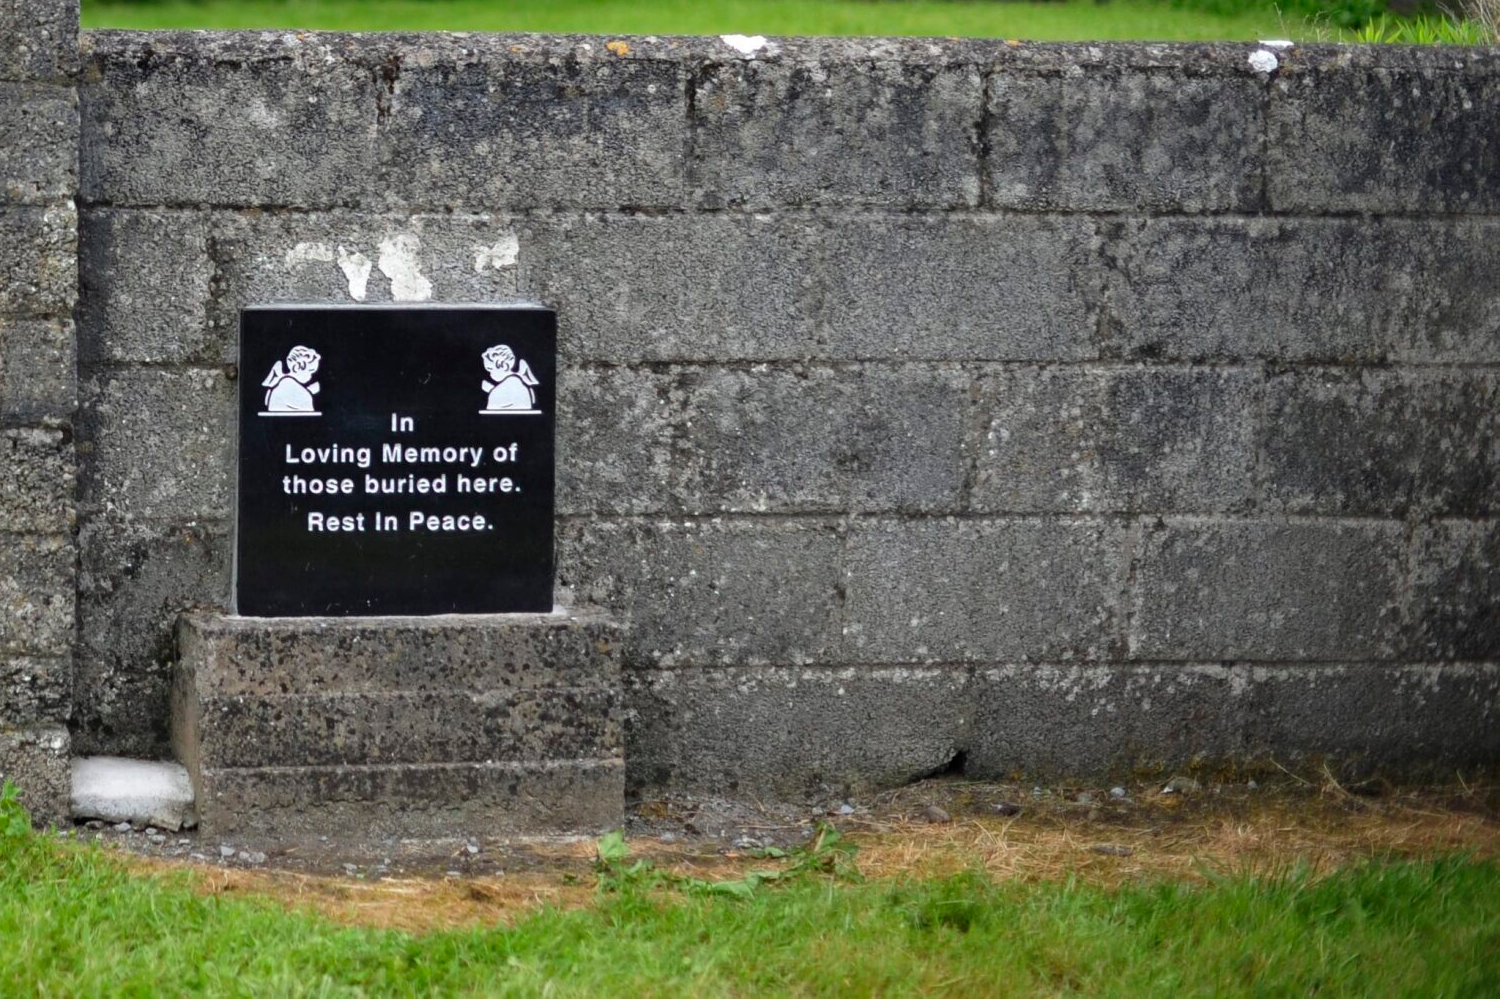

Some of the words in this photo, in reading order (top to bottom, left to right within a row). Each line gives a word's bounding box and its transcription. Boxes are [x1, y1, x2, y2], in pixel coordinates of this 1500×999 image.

[390, 412, 415, 433] In
[285, 443, 371, 468] Loving
[382, 443, 484, 468] Memory
[492, 442, 519, 464] of
[282, 474, 355, 495] those
[364, 473, 447, 495] buried
[457, 473, 522, 494] here.
[307, 511, 366, 532] Rest
[375, 511, 399, 532] In
[409, 511, 494, 532] Peace.
